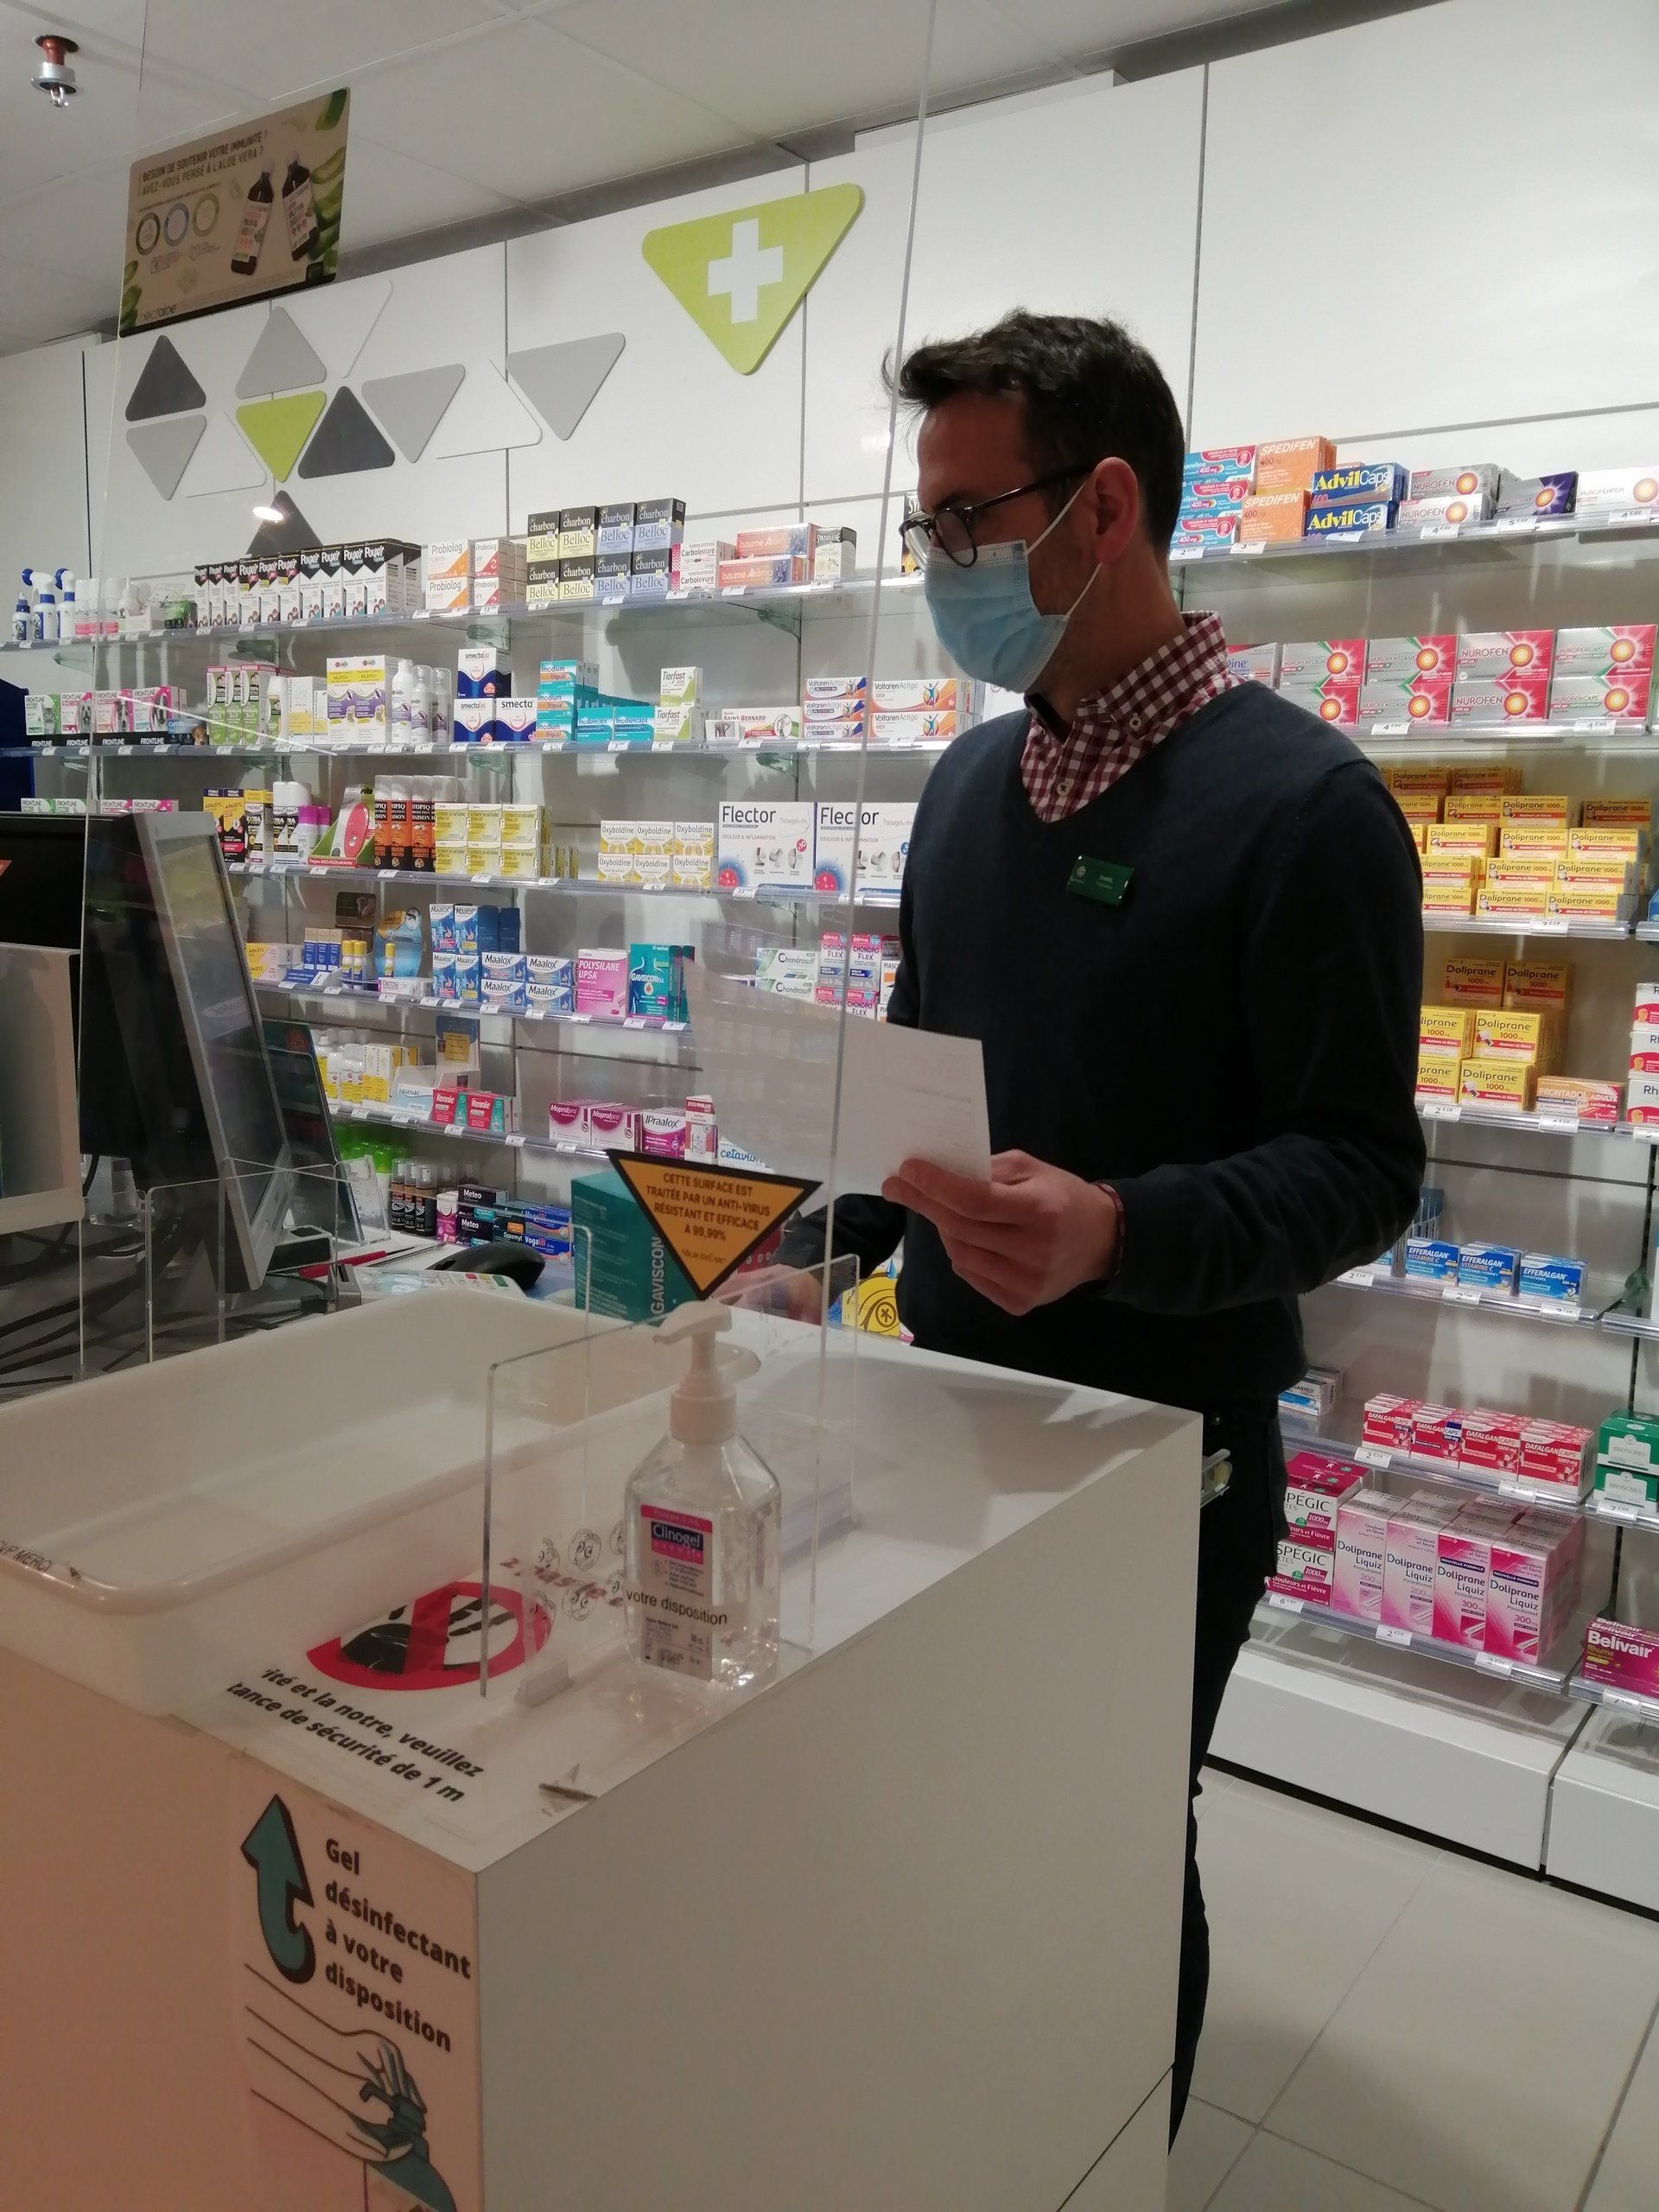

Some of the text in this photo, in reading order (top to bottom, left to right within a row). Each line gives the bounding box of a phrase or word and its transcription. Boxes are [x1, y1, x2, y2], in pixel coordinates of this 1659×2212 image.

[143, 166, 165, 181] BESOIN
[166, 163, 175, 174] DE
[176, 150, 207, 173] SOUTENIR
[209, 144, 229, 159] VOTRE
[143, 176, 180, 195] AVEZ-VOUS
[238, 149, 257, 166] VERA
[1262, 439, 1315, 455] SPEDIFEN
[1260, 457, 1274, 466] 400
[1413, 480, 1454, 491] NUROFEN
[1244, 493, 1301, 508] SPEDIFEN
[601, 513, 630, 524] charbon
[639, 508, 669, 518] charbon
[1402, 507, 1444, 518] NUROFEN
[530, 522, 556, 532] charbon
[563, 516, 591, 528] charbon
[601, 529, 628, 542] Belloc
[638, 525, 667, 538] Belloc
[530, 537, 556, 550] Belloc
[563, 533, 590, 546] Belloc
[682, 548, 715, 556] Carbolevure
[681, 575, 715, 584] Carbolevure
[1461, 648, 1508, 658] NUROFEN
[663, 671, 685, 682] Tiorfast
[1457, 696, 1503, 705] NUROFEN
[658, 709, 680, 719] Tiorfast
[722, 806, 776, 823] Flector
[602, 826, 633, 836] Oxyboldine
[637, 827, 671, 836] Oxyboldine
[677, 825, 711, 836] Oxyboldine
[486, 955, 512, 966] Maalox
[530, 958, 557, 969] Maalox
[779, 952, 814, 965] Chondrosulf
[579, 961, 620, 971] POLYSILANE
[484, 982, 512, 993] Maalox
[529, 987, 556, 997] Maalox
[1478, 1019, 1530, 1031] Doliprane
[1463, 1070, 1516, 1082] Doliprane
[436, 1094, 455, 1103] Rennie
[471, 1099, 490, 1109] Rennie
[664, 1173, 753, 1196] CETTE SURFACE EST
[464, 1190, 481, 1198] Meteo
[646, 1185, 771, 1217] TRAITÉE PAR UN ANTI-VIRUS
[654, 1203, 760, 1230] RÉSISTANT ET EFFICACE
[461, 1219, 479, 1229] Meteo
[1408, 1254, 1433, 1262] VITAMINE
[1409, 1247, 1450, 1259] EFFERALGAN
[1462, 1256, 1502, 1268] EFFERALGAN
[651, 1236, 664, 1314] GAVISCON
[1523, 1268, 1566, 1281] EFFERALGAN
[652, 1522, 701, 1548] Clinogel
[1312, 1530, 1330, 1540] Fièvre
[14, 1549, 55, 1572] MERCI
[1387, 1554, 1433, 1573] Doliprane
[1406, 1569, 1433, 1583] Liquiz
[1438, 1567, 1484, 1586] Doliprane
[1273, 1576, 1300, 1586] Douleurs
[1307, 1585, 1326, 1594] Fièvre
[1457, 1583, 1484, 1596] Liquiz
[1490, 1580, 1539, 1600] Doliprane
[626, 1590, 728, 1625] votre disposition
[1462, 1599, 1478, 1610] 300
[1510, 1597, 1538, 1610] Liquiz
[1587, 1644, 1614, 1656] Rhume
[1588, 1630, 1652, 1658] Belivair
[291, 1681, 315, 1698] et
[314, 1691, 337, 1709] la
[334, 1703, 393, 1738] notre,
[398, 1732, 485, 1778] veuillez
[281, 1707, 309, 1726] de
[305, 1719, 392, 1766] sécurité
[391, 1762, 423, 1781] de
[420, 1777, 438, 1789] 1
[436, 1783, 466, 1802] m
[326, 1839, 359, 1876] Gel
[326, 1881, 471, 1980] désinfectant
[326, 1917, 404, 1984] à votre
[326, 1962, 450, 2053] disposition
